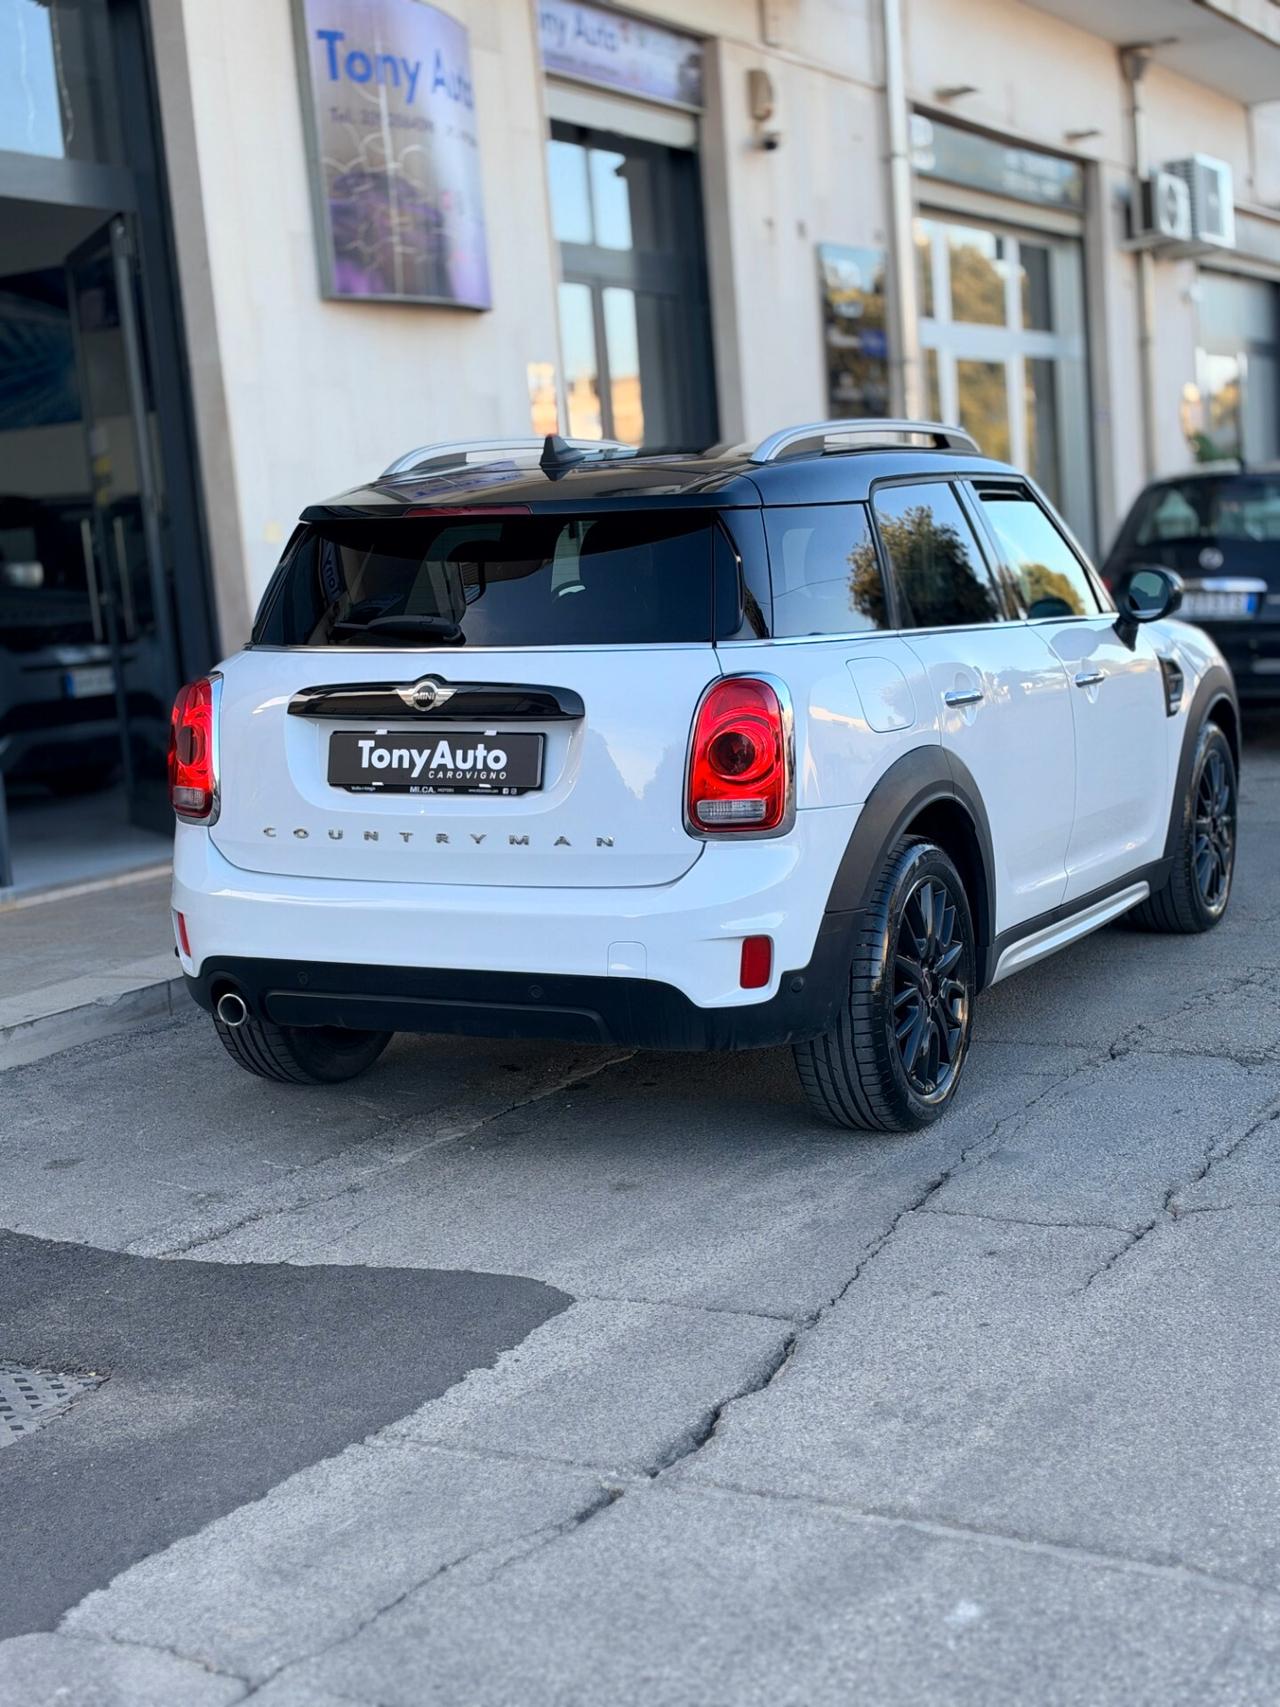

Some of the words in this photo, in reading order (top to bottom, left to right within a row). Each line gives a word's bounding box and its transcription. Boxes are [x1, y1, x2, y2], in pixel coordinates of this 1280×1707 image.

[316, 29, 421, 105] Tony
[415, 691, 436, 701] MINI
[357, 739, 508, 778] TonyAuto
[428, 770, 507, 780] CAROVIGNO
[263, 827, 615, 848] COUNTRYMAN
